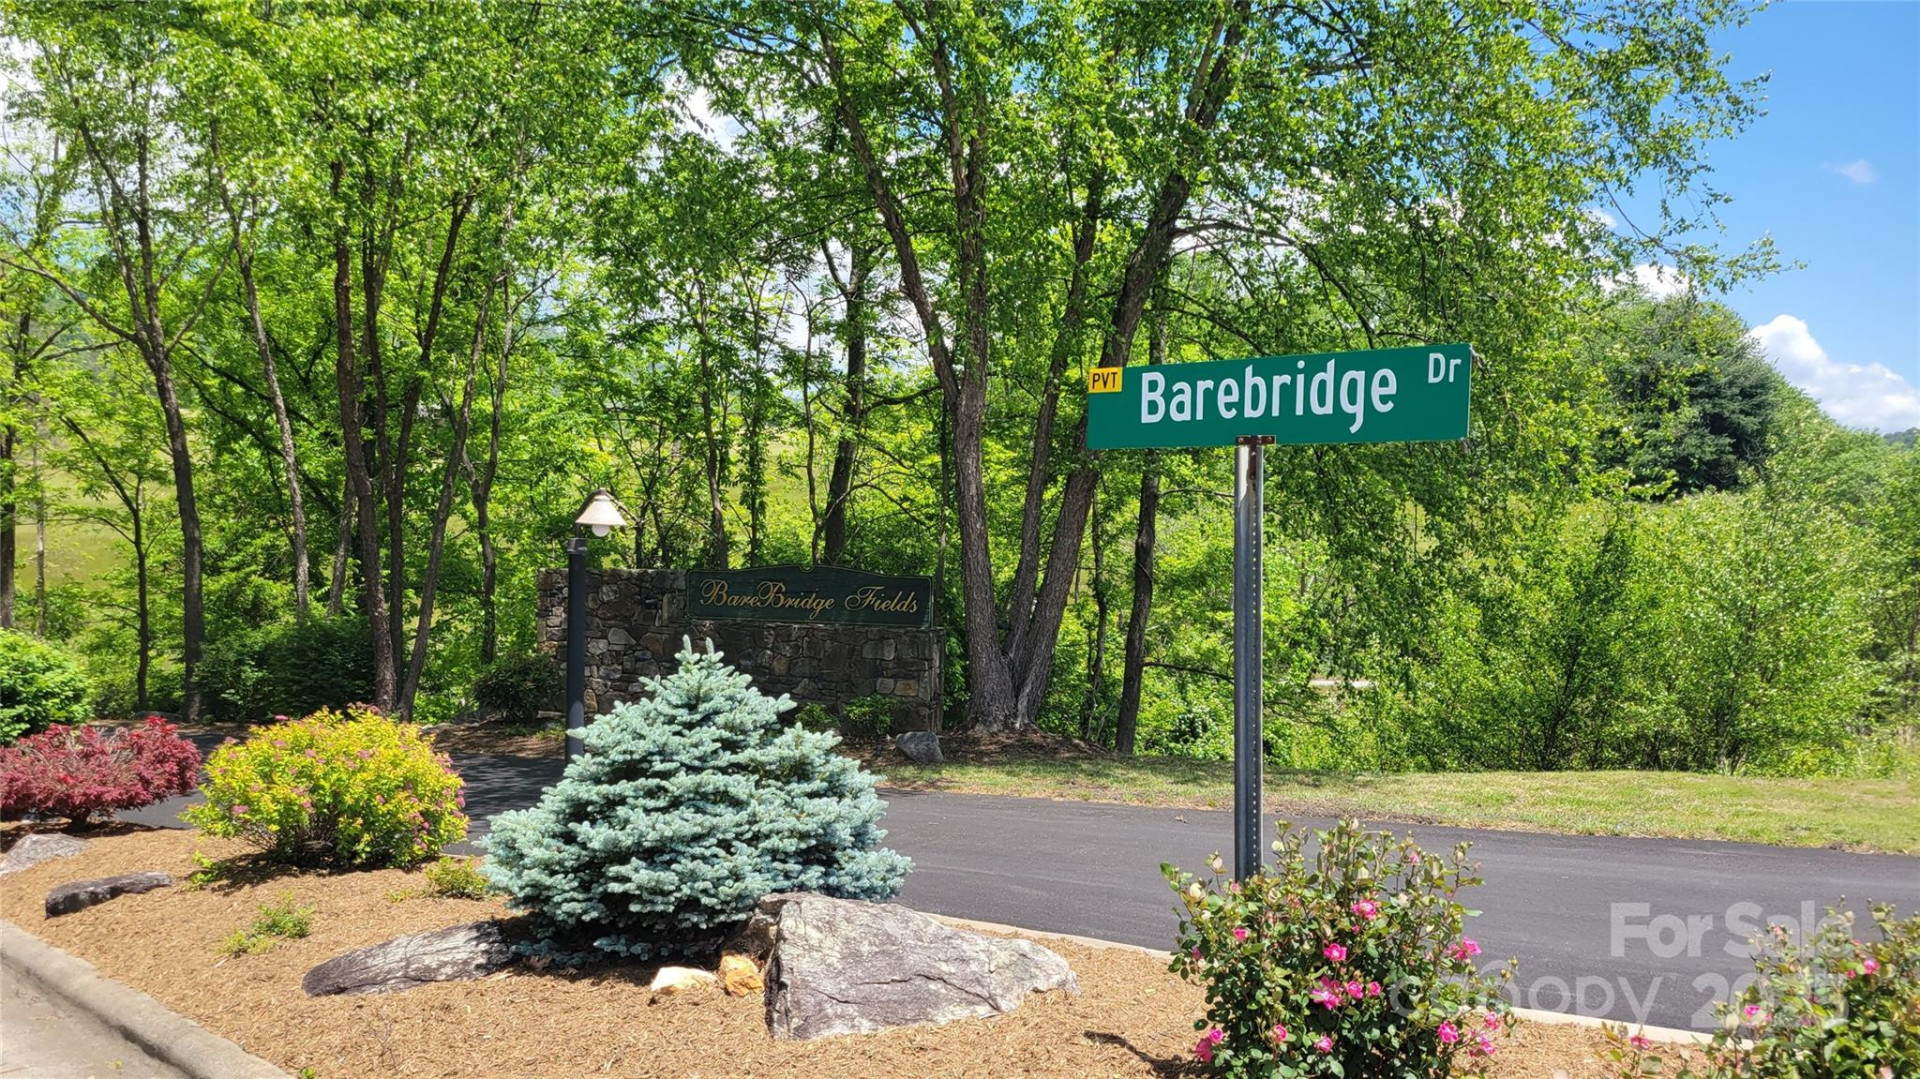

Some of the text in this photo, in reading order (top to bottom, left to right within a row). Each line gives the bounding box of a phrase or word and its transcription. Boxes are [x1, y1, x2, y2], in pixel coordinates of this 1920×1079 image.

[1091, 353, 1462, 434] PVT Barebridge Dr
[700, 579, 919, 620] BareBridge Fields
